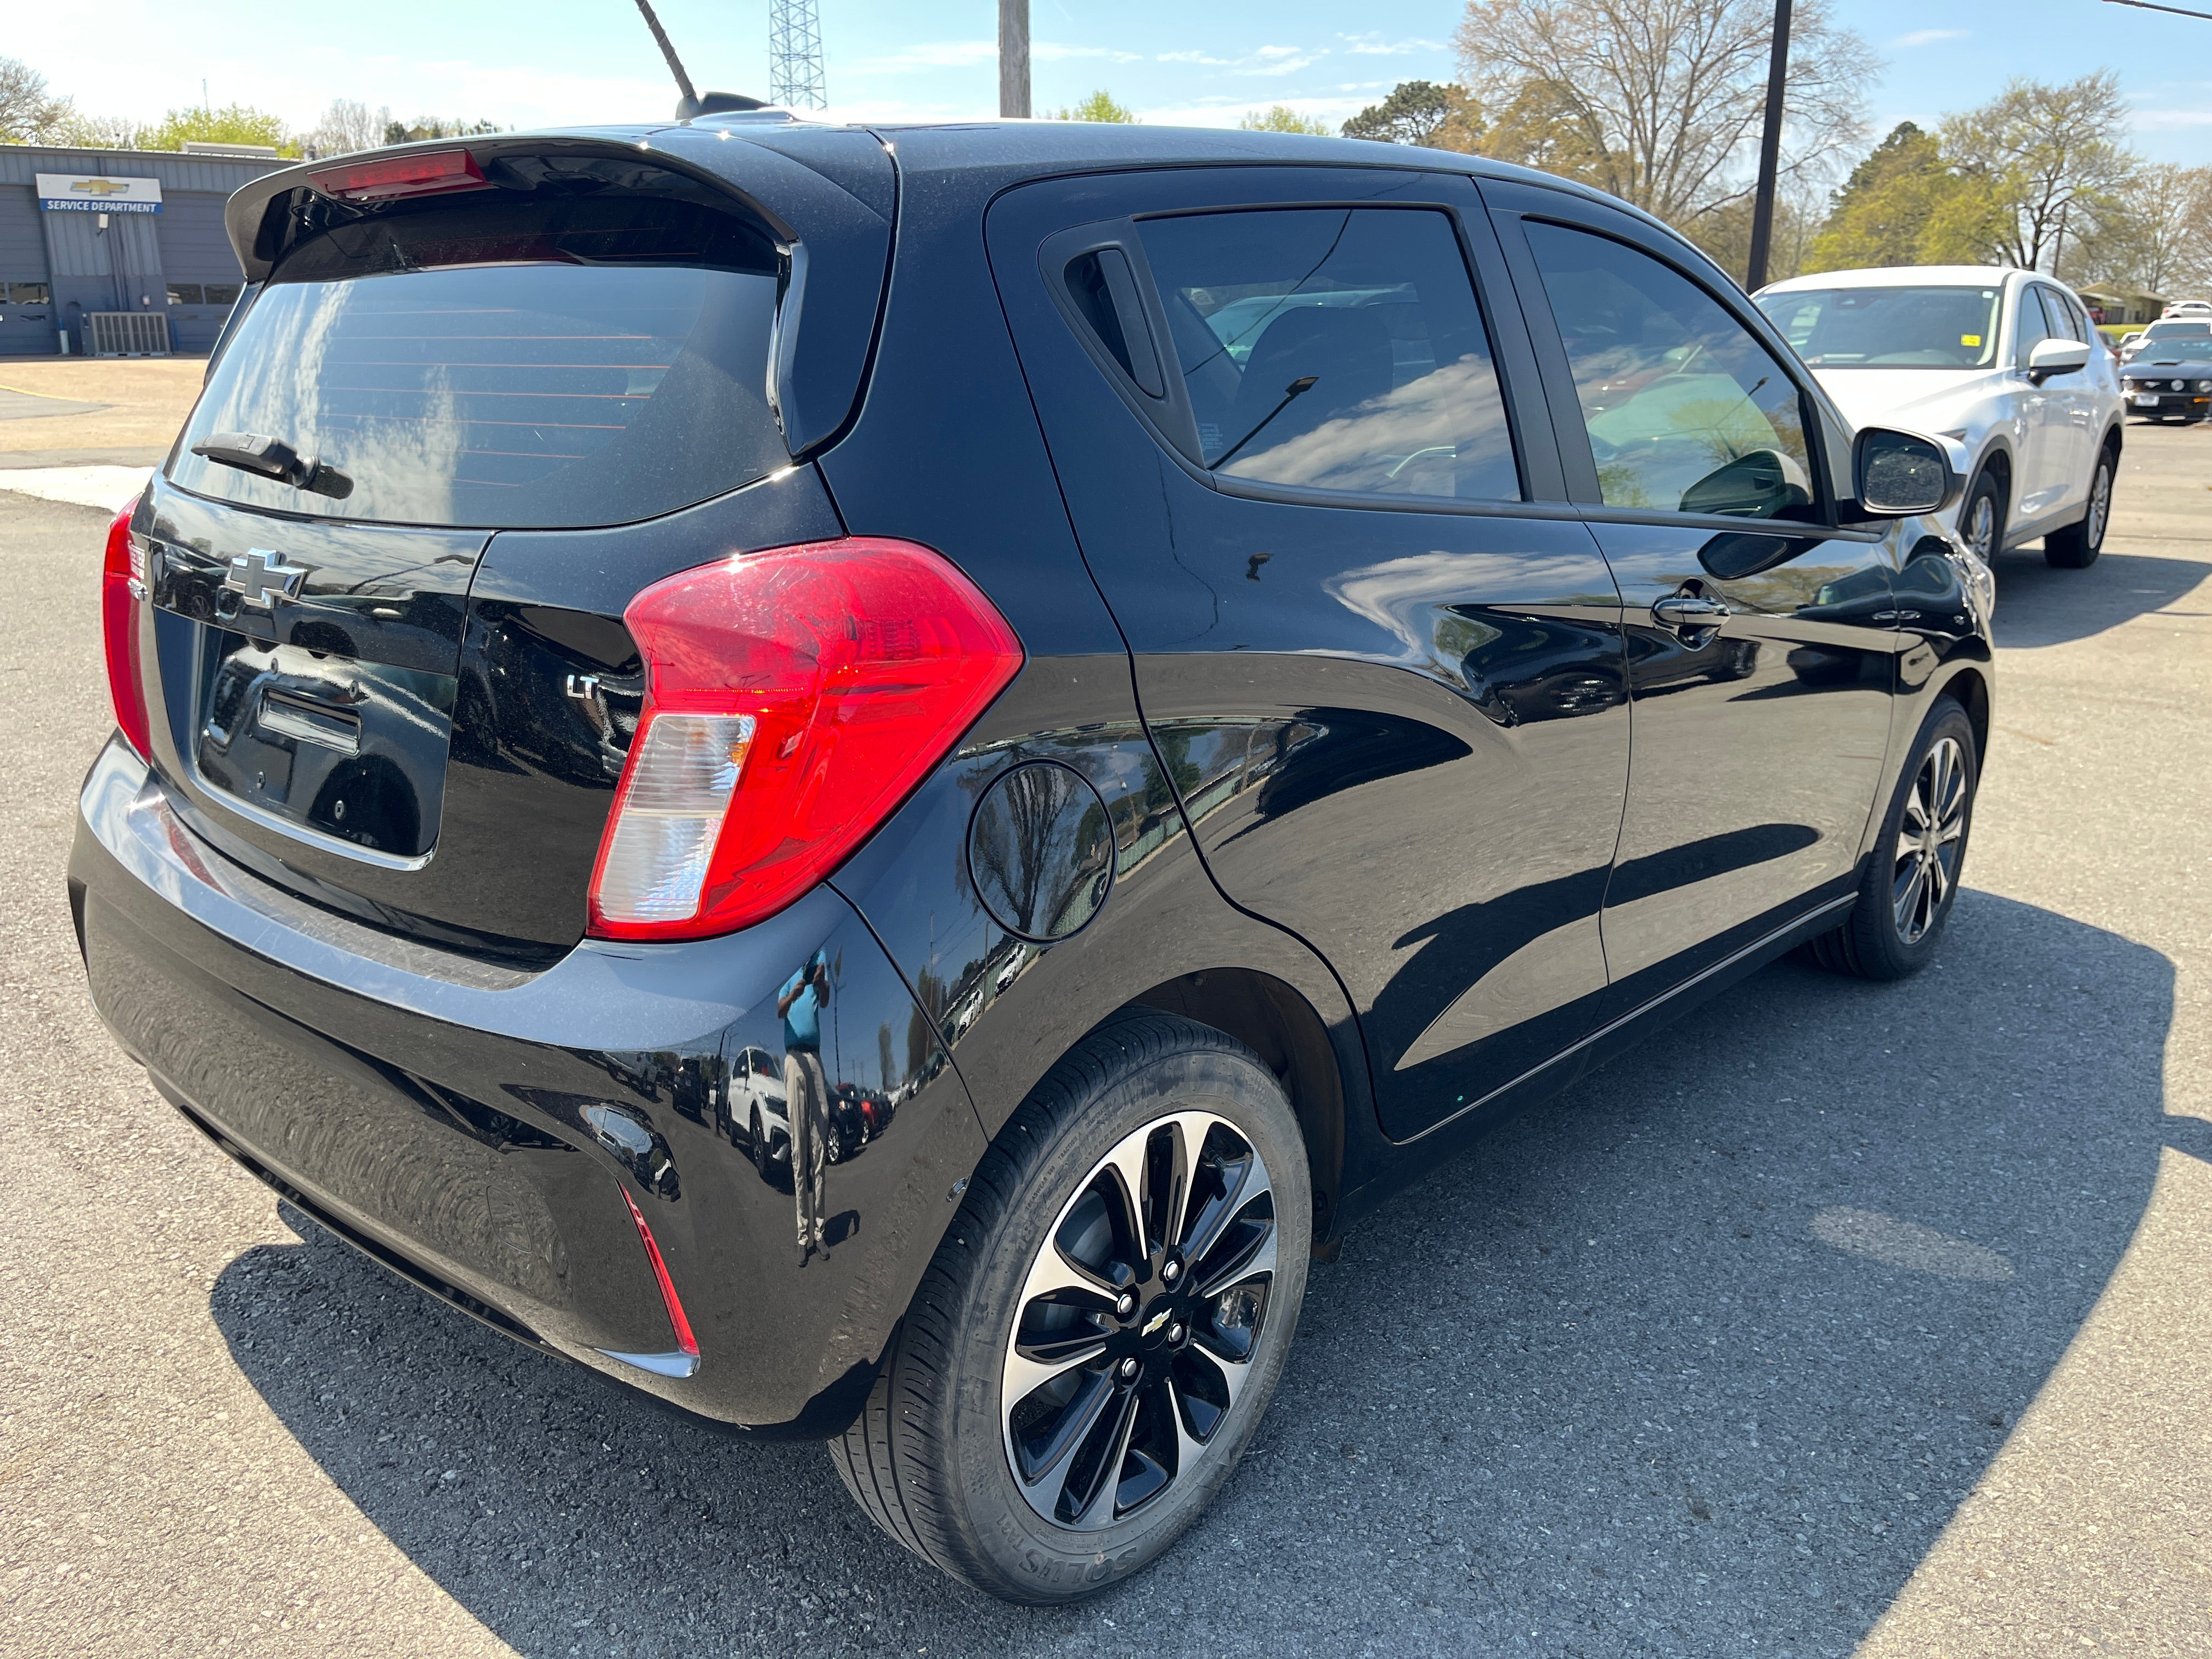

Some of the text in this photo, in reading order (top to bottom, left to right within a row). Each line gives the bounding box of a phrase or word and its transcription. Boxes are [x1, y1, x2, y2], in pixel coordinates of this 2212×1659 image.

[47, 200, 156, 213] SERVICE DEPARTMENT
[567, 675, 600, 699] LT
[1057, 1135, 1077, 1162] TRACTION
[1018, 1544, 1138, 1585] SOLUS
